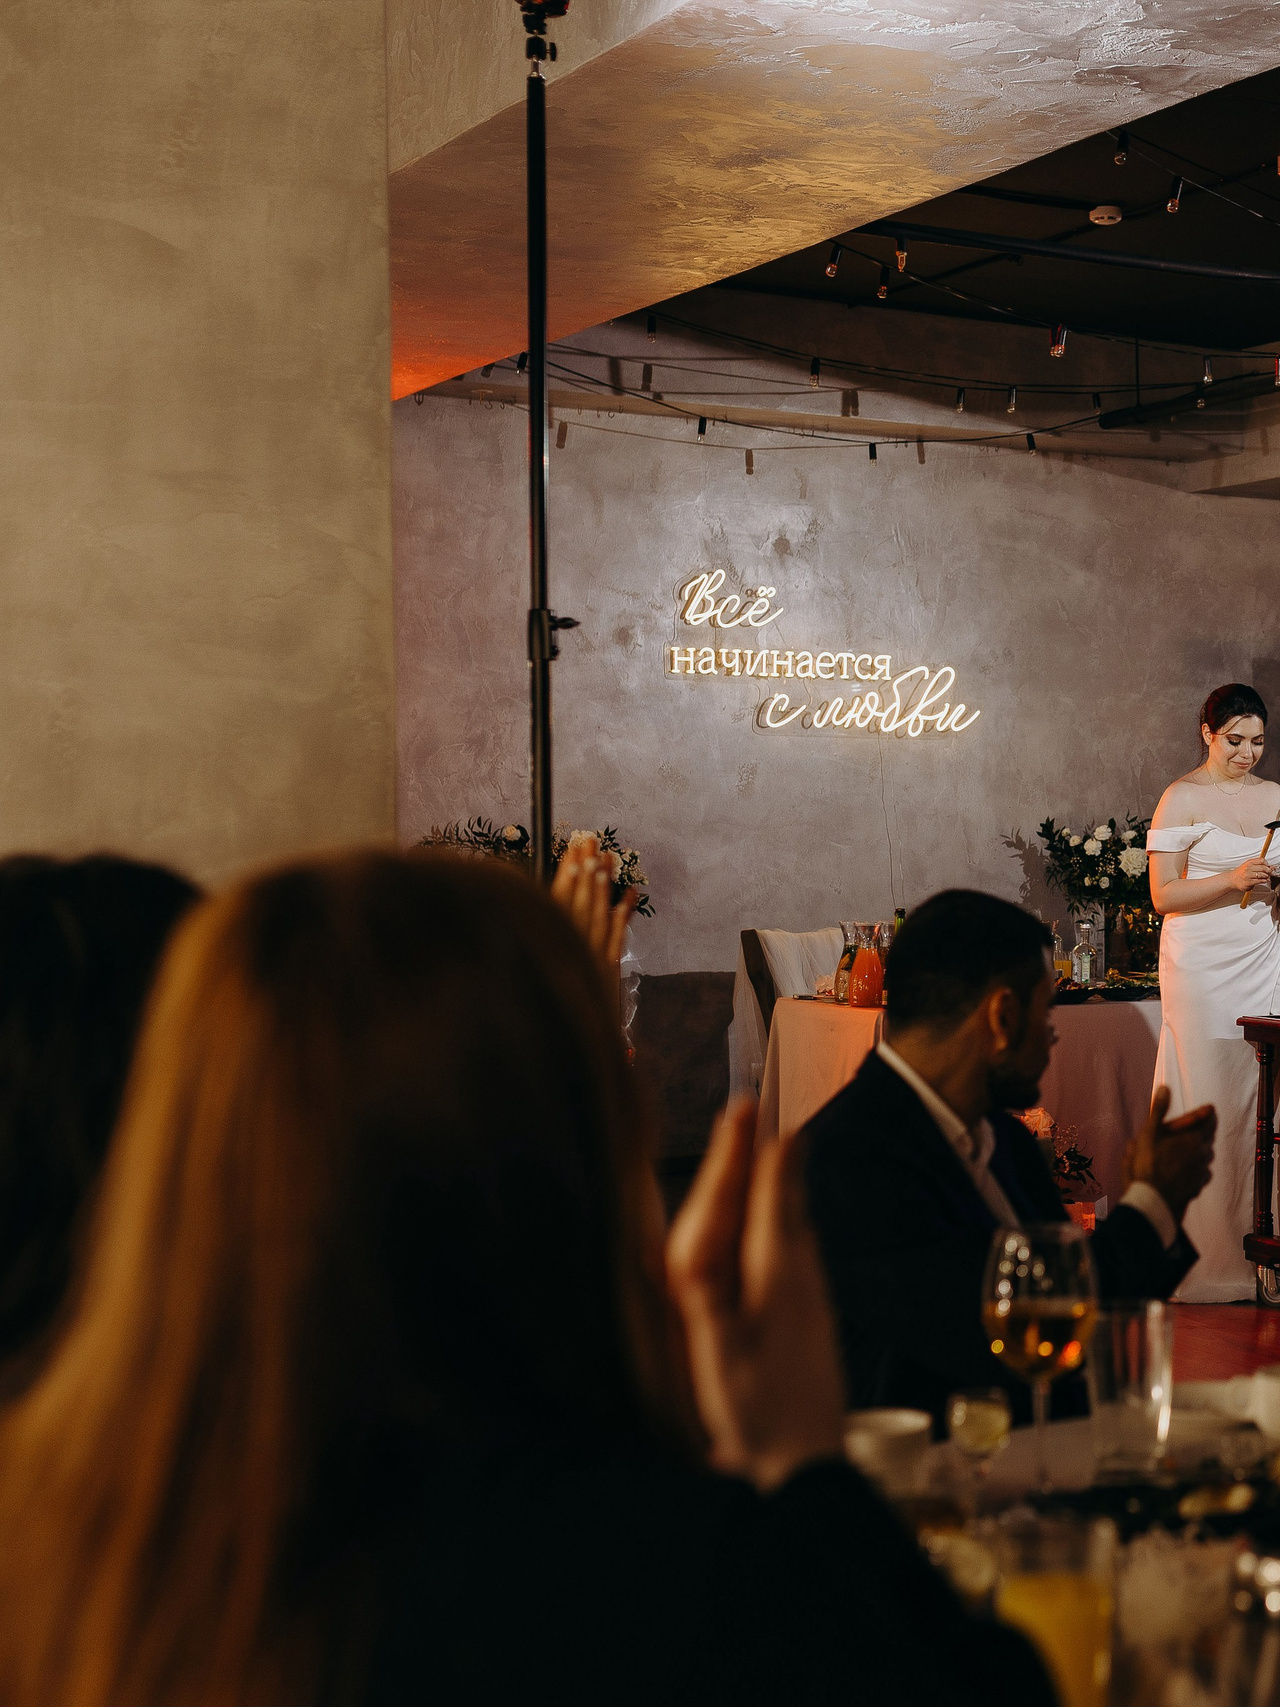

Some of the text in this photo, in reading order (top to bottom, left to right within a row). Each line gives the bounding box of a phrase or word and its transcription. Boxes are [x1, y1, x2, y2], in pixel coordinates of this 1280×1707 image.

[685, 569, 784, 628] Всё
[670, 646, 893, 681] начинается
[766, 665, 981, 737] с любви
